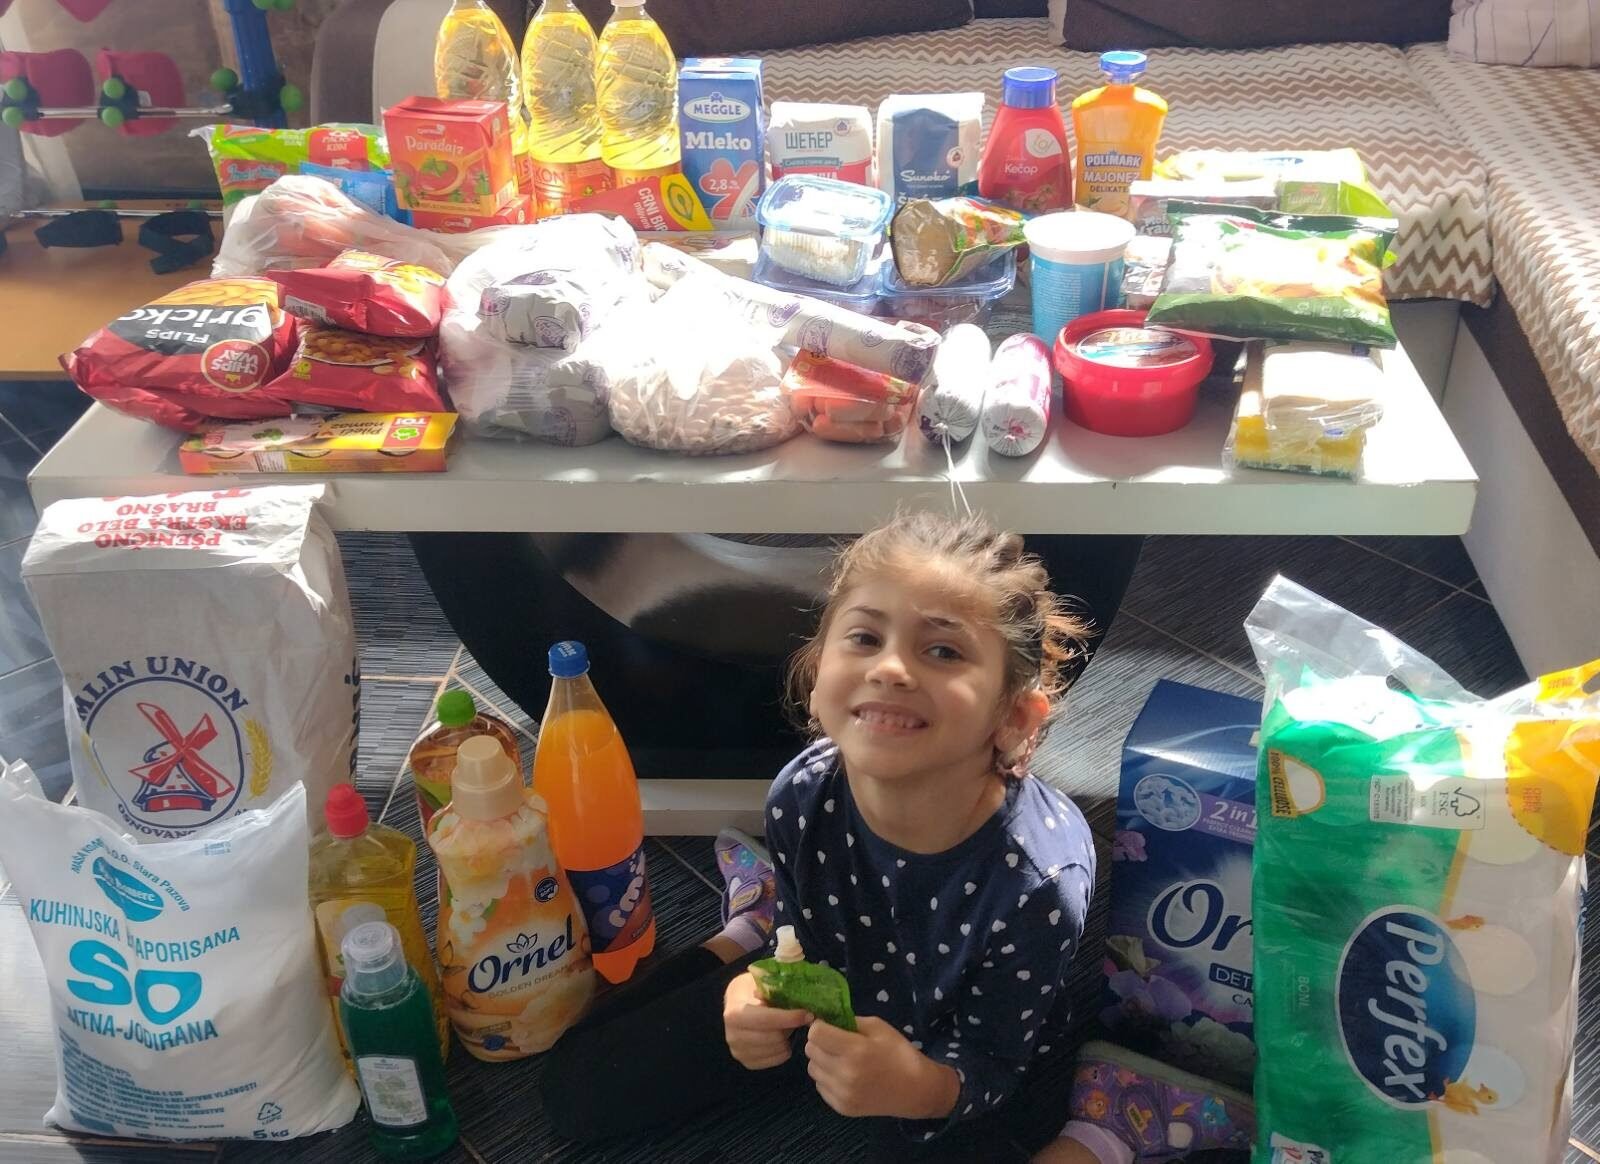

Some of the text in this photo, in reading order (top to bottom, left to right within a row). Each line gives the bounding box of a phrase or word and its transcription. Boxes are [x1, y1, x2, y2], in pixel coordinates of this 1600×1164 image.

[693, 104, 742, 116] MEGGLE
[404, 135, 464, 154] Paradajz
[685, 131, 752, 150] Mleko
[785, 131, 833, 149] ШЕЋЕР
[1004, 163, 1038, 176] Kečop
[1086, 154, 1141, 167] POLIMARK
[709, 179, 728, 192] 2,8
[1090, 185, 1131, 193] DELIKATE
[638, 187, 660, 215] CRNI
[145, 329, 210, 344] FLIPS
[220, 349, 258, 366] WAY
[211, 359, 258, 375] CHIPS
[117, 501, 218, 518] BRAŠNO
[77, 514, 248, 533] EKSTRA BELO
[95, 533, 222, 550] PŠENIČNO
[74, 656, 249, 722] MLIN UNION
[1209, 801, 1229, 822] 2
[1229, 806, 1248, 822] in
[1439, 792, 1449, 817] FSC
[132, 860, 160, 884] Stara
[160, 879, 191, 912] Pazova
[30, 899, 120, 942] KUHINJSKA
[468, 914, 577, 994] Ornel
[67, 940, 202, 1026] SO
[487, 981, 533, 999] GOLDEN
[1367, 921, 1448, 1101] Perfex
[253, 1129, 268, 1139] 5
